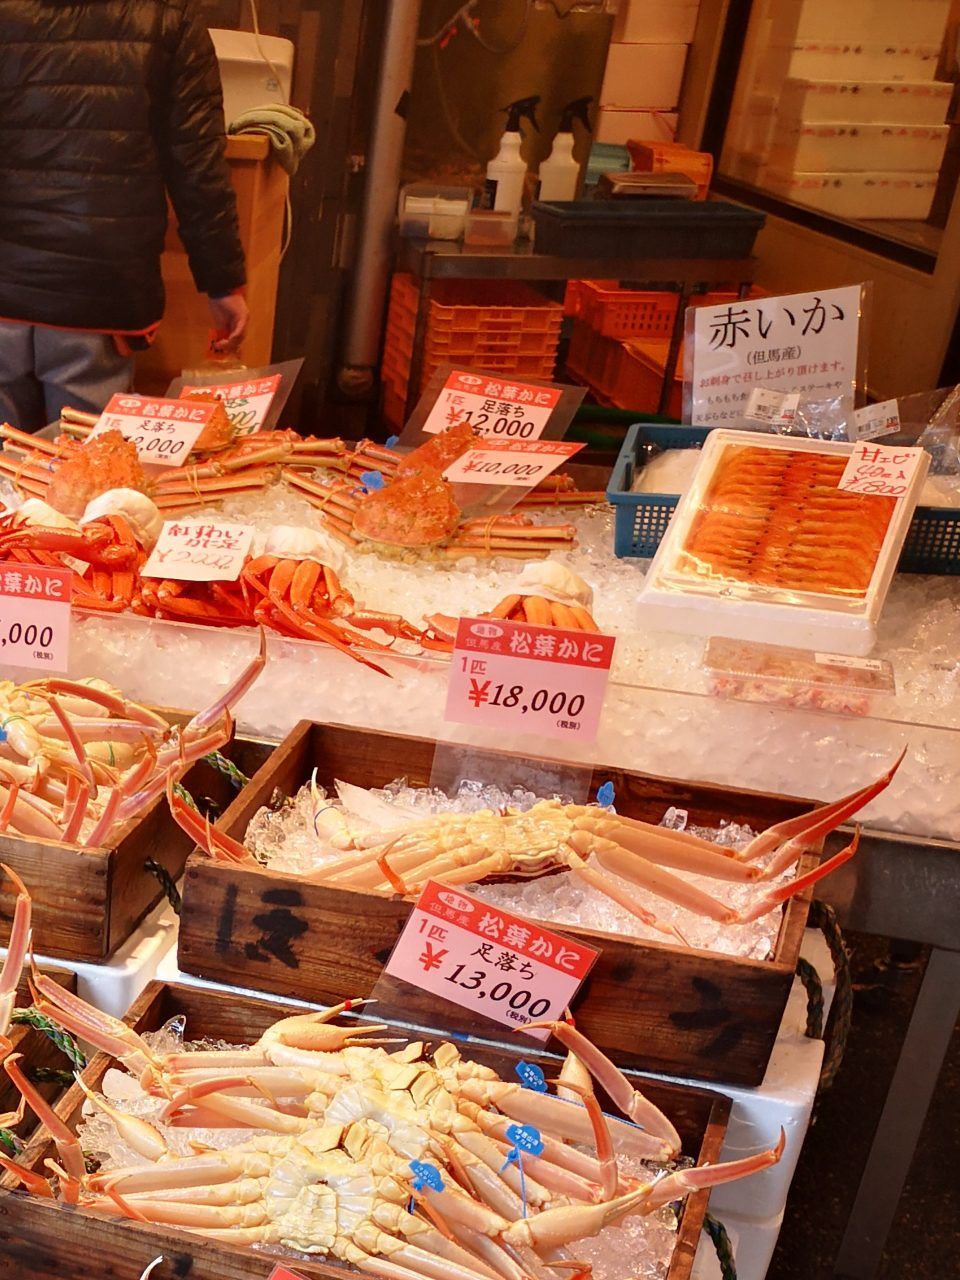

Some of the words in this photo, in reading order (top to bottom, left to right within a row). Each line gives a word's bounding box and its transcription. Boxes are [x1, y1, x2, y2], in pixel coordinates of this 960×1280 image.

[708, 296, 845, 351] 赤いか
[746, 345, 802, 366] (但馬産)
[484, 382, 552, 405] 松葉かに
[142, 403, 207, 421] 松葉かに
[480, 399, 525, 418] 足落ち
[136, 419, 176, 434] 足落ち
[509, 630, 604, 663] 松葉かに
[461, 656, 487, 675] 1匹
[468, 678, 586, 717] ¥18,000
[417, 918, 449, 943] 1匹
[478, 911, 582, 971] 松葉かに
[470, 942, 537, 981] 足落ち
[418, 941, 552, 1018] ¥13,000
